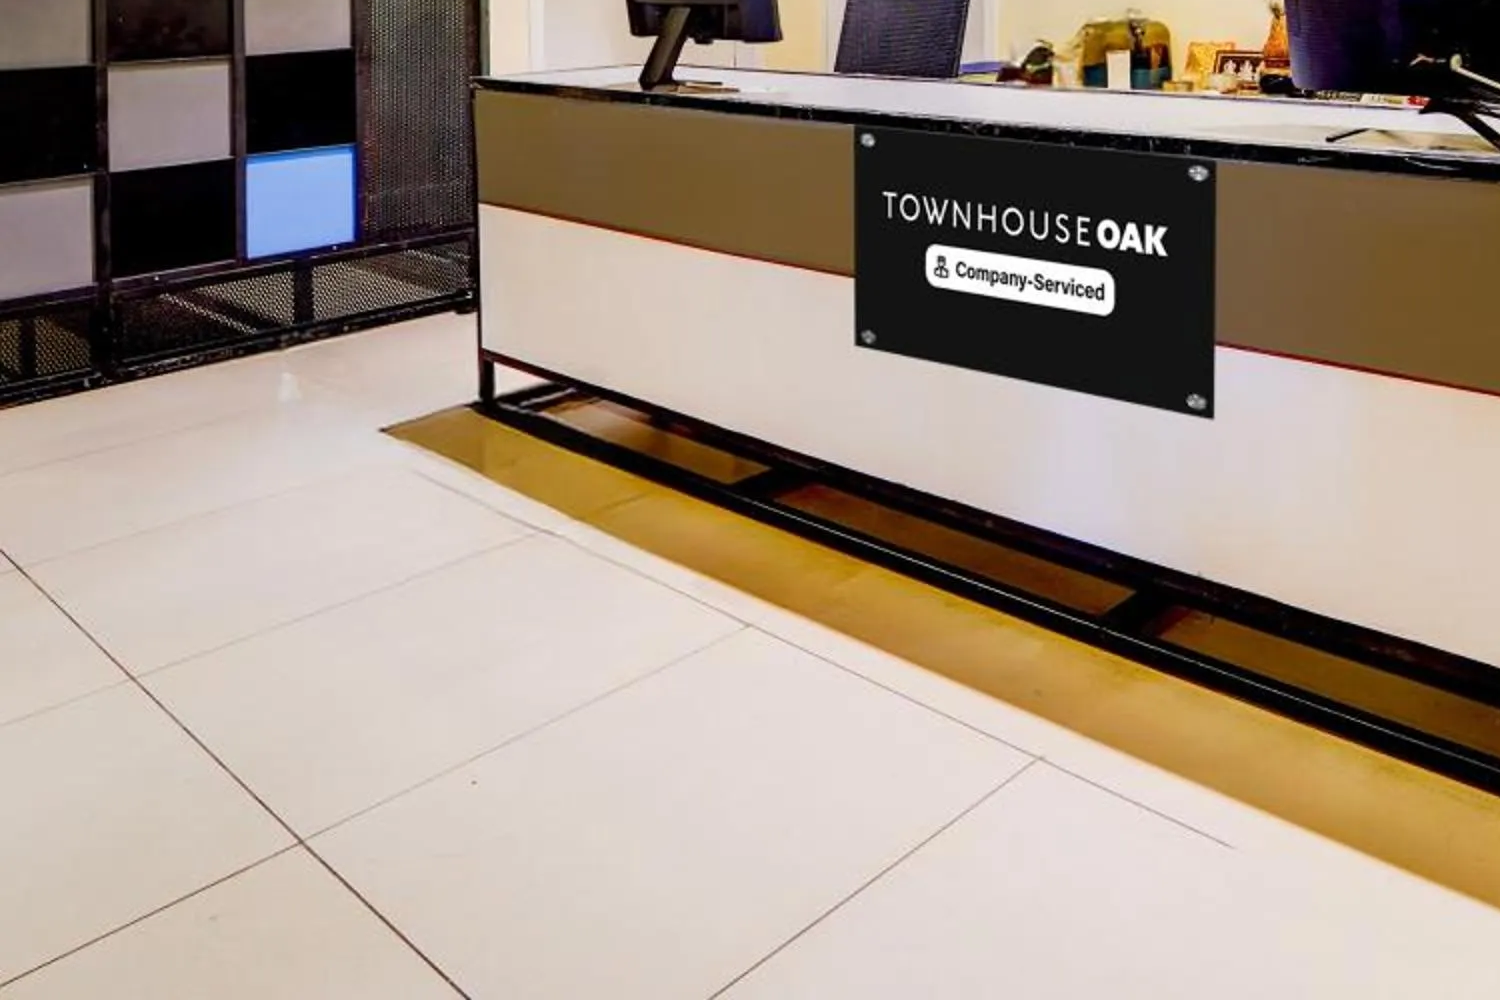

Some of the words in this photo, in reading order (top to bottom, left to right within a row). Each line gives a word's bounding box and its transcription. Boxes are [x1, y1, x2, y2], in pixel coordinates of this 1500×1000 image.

[882, 191, 1091, 247] TOWNHOUSE
[1096, 218, 1168, 257] OAK
[955, 261, 1105, 301] Company-Serviced
